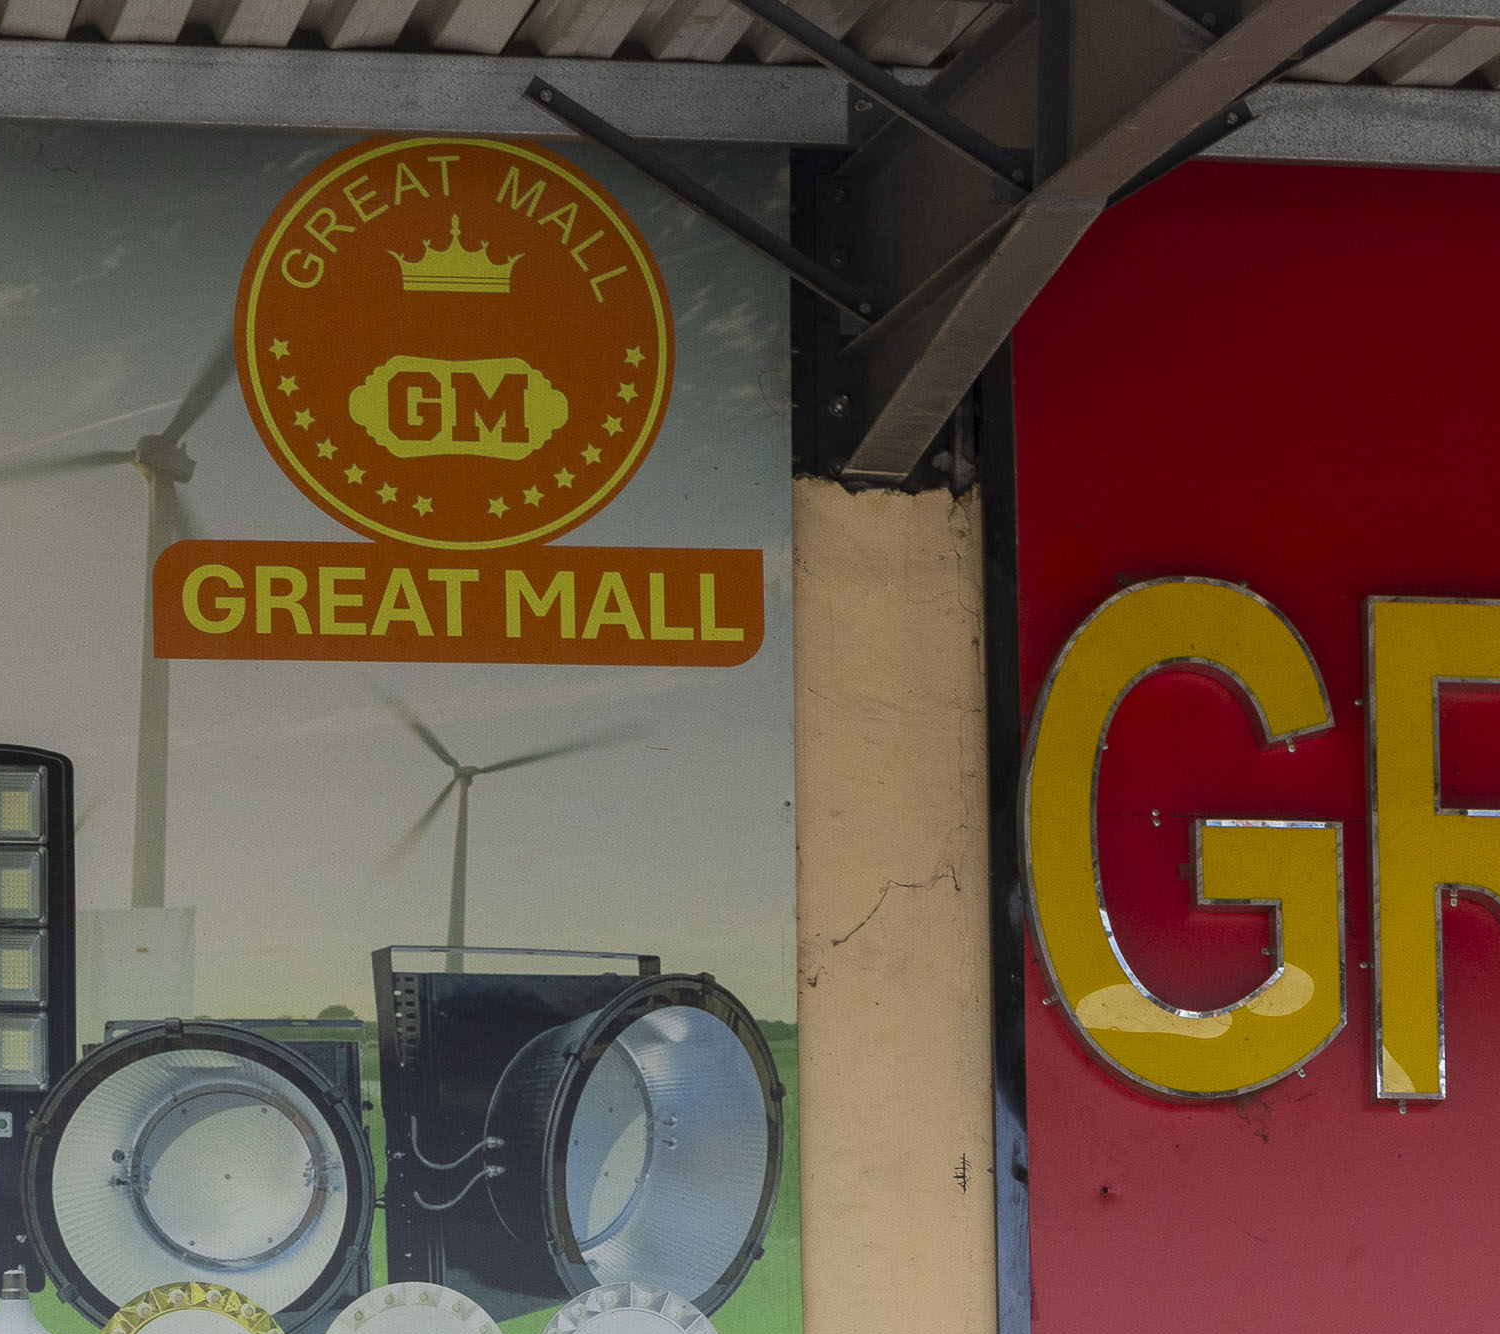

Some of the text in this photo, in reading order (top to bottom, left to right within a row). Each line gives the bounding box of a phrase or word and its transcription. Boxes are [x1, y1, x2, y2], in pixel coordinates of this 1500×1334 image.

[281, 154, 628, 303] GREAT MALL
[387, 371, 531, 444] GM
[181, 563, 745, 643] GREAT MALL
